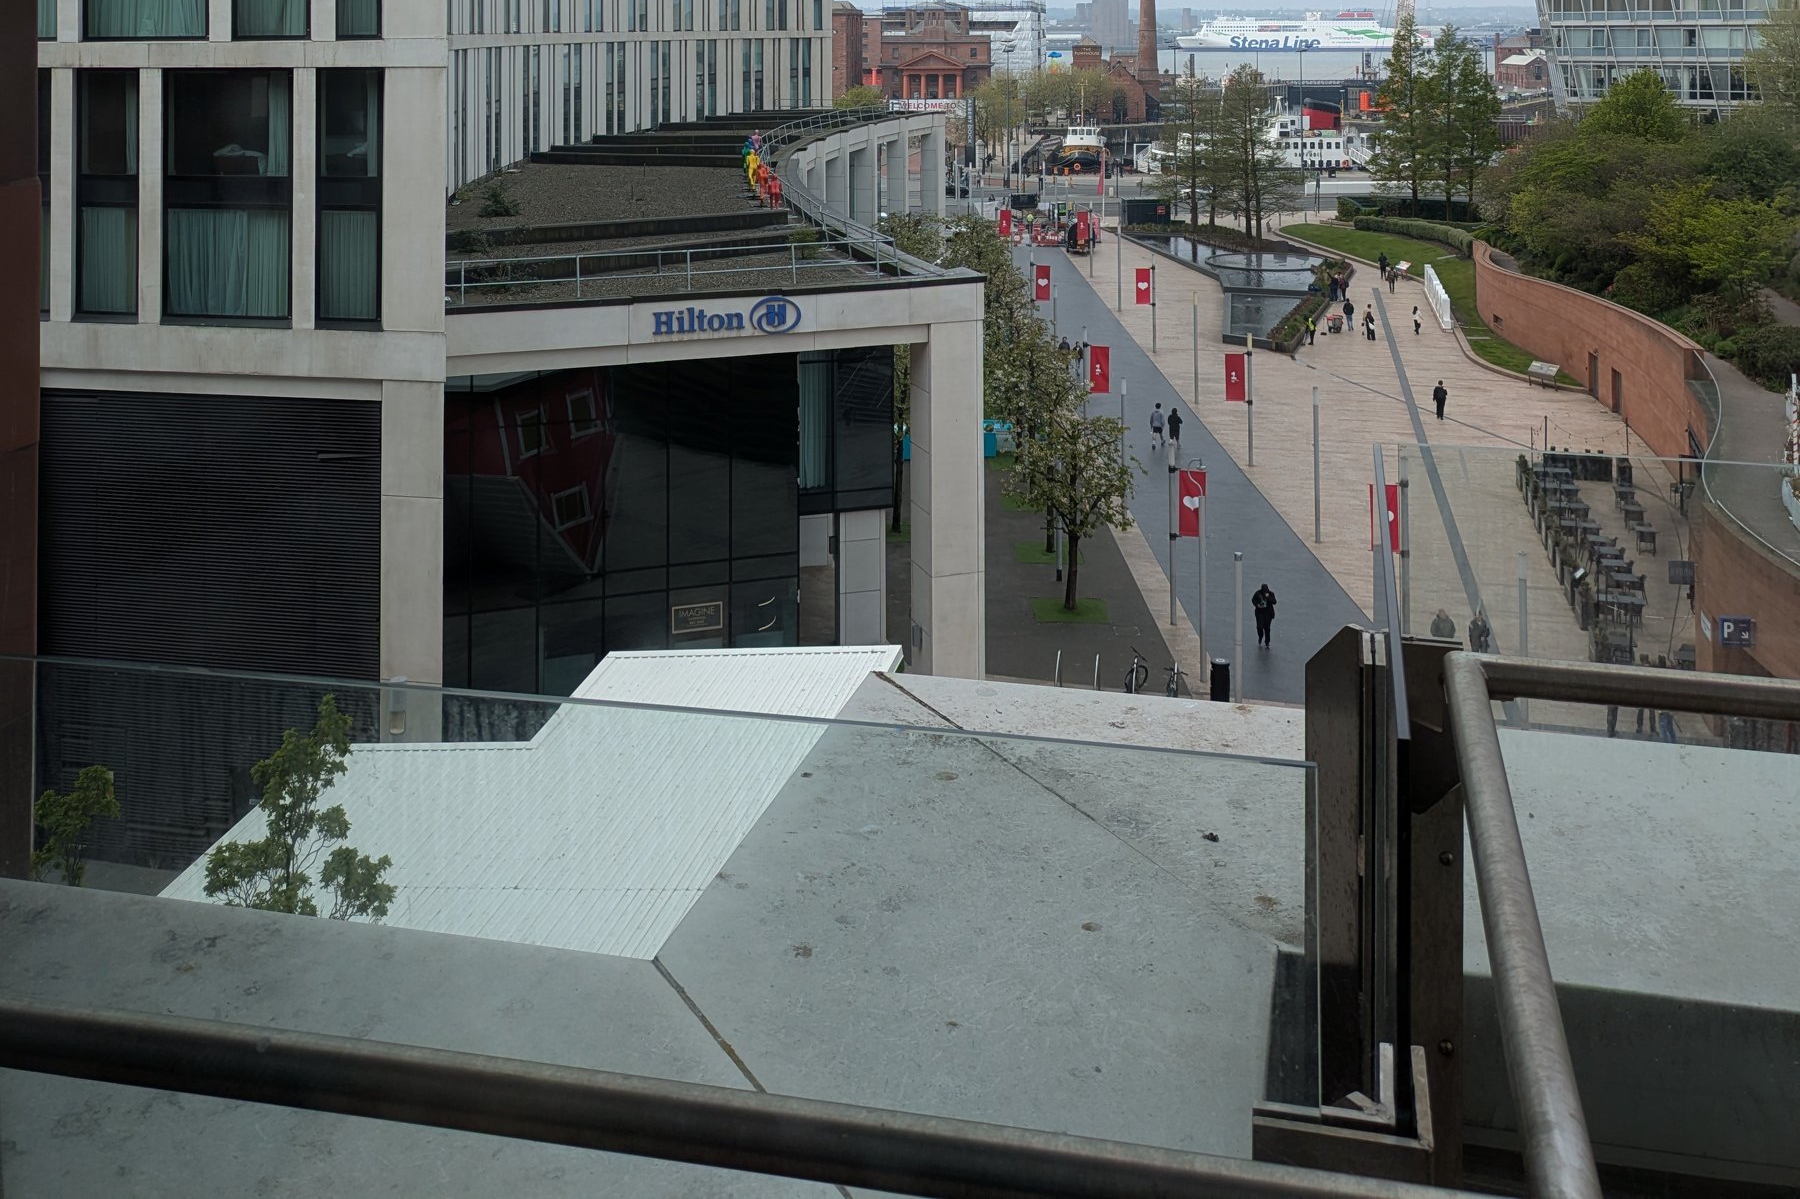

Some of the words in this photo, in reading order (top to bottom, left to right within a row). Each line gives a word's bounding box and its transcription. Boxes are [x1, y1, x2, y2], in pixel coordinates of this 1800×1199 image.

[1229, 35, 1280, 49] Stena
[1283, 35, 1321, 49] Line
[901, 102, 943, 110] WELCOME
[653, 307, 745, 335] Hilton
[679, 606, 715, 618] IMAGINE
[1723, 621, 1735, 638] P
